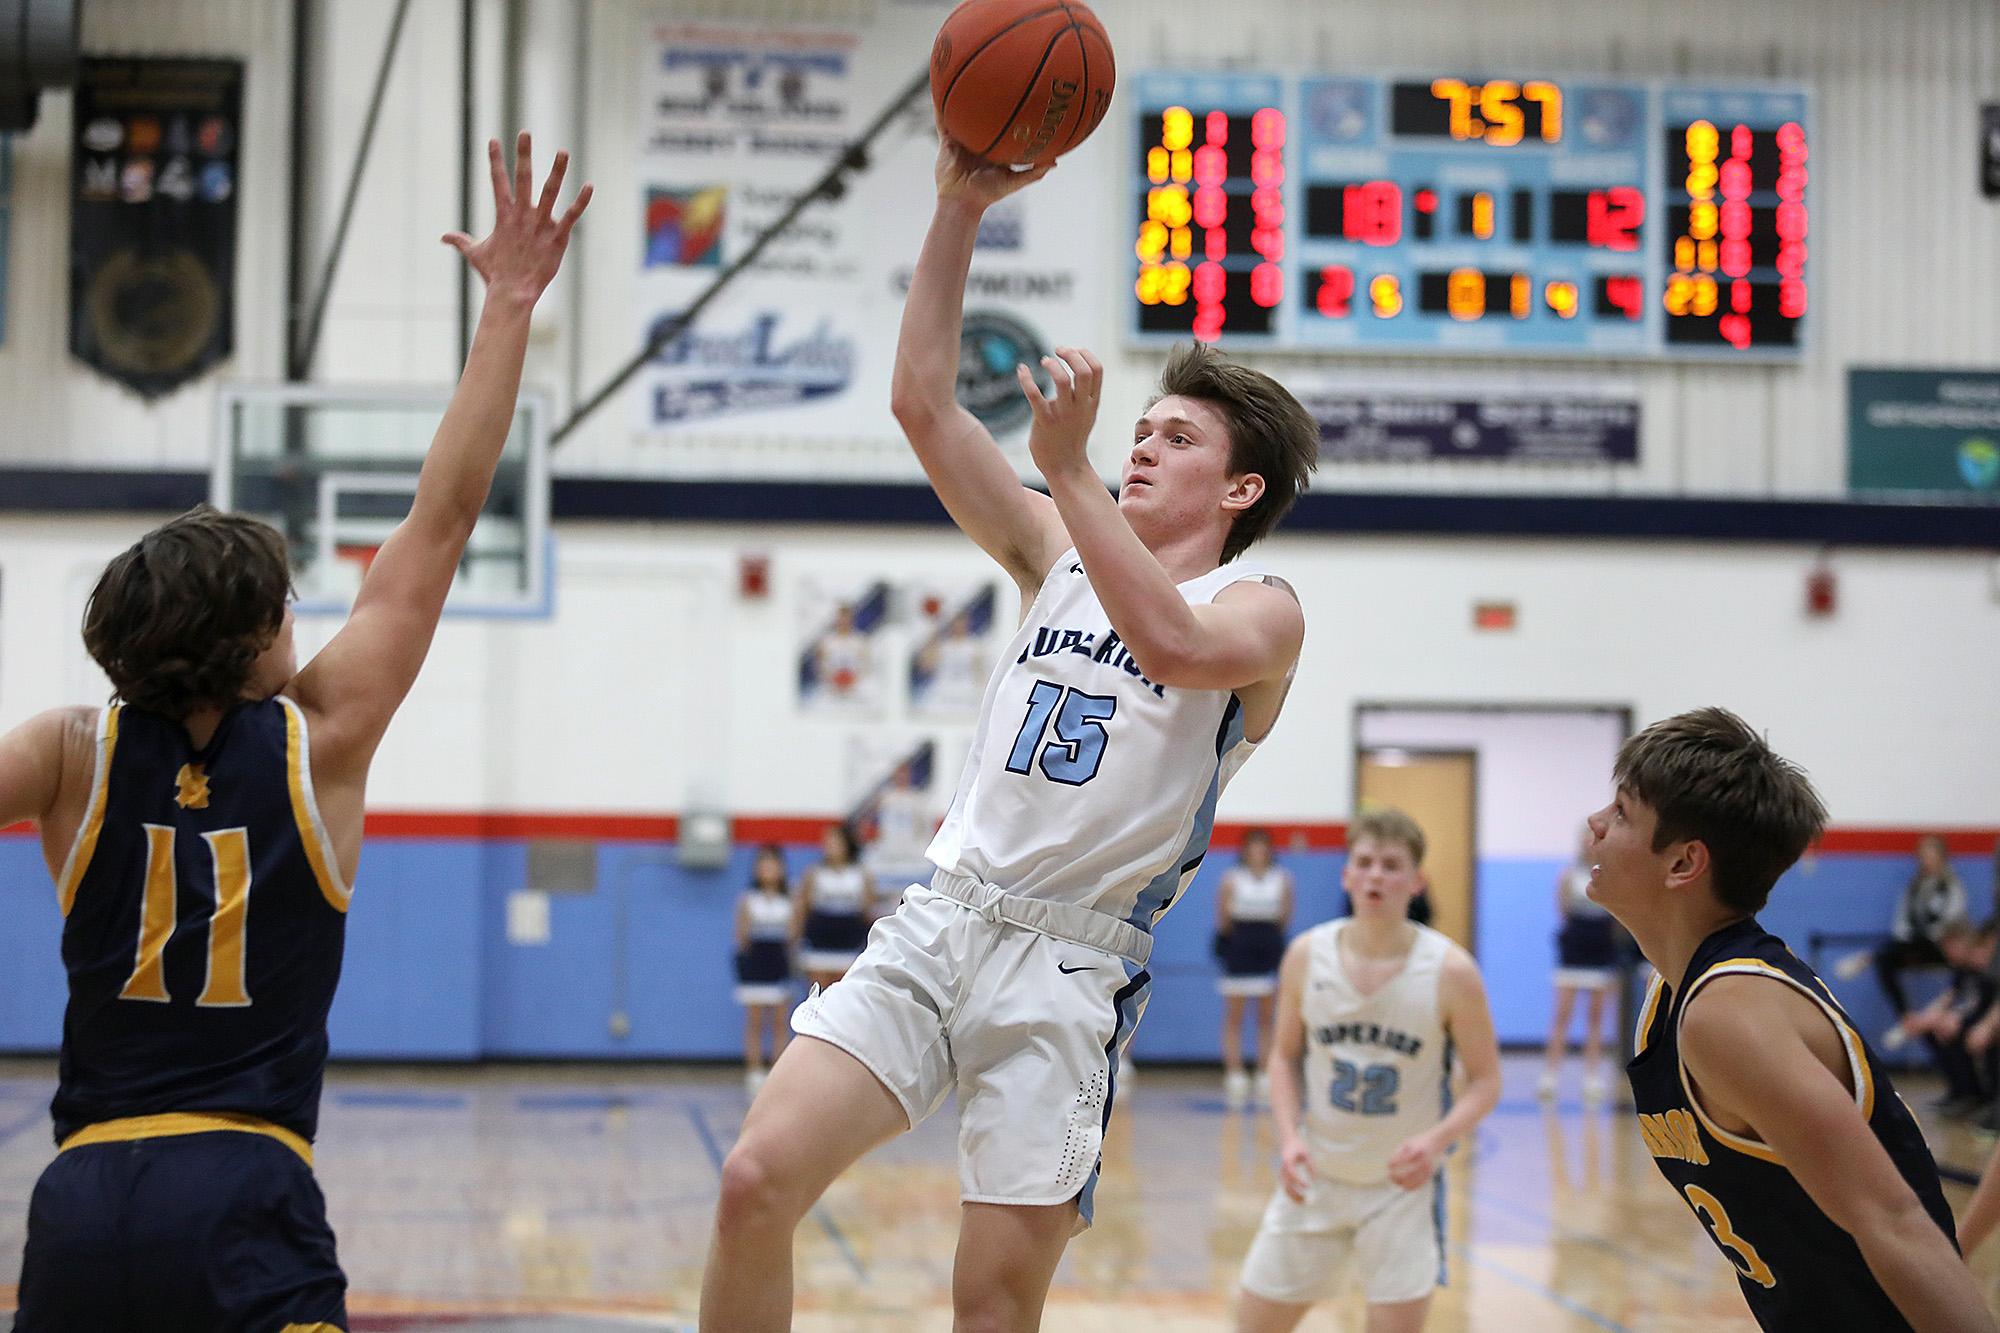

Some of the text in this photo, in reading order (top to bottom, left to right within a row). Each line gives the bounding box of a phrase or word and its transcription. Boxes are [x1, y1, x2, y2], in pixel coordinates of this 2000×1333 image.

[1431, 78, 1564, 147] 7:57
[1343, 181, 1403, 247] 18
[1472, 192, 1494, 239] 1
[1587, 187, 1646, 252] 12
[1316, 265, 1355, 319] 2
[1016, 626, 1166, 699] UPERIO
[1004, 679, 1118, 788] 15
[117, 822, 254, 1008] 11
[1329, 1058, 1398, 1115] 22
[1683, 1182, 1778, 1290] 3
